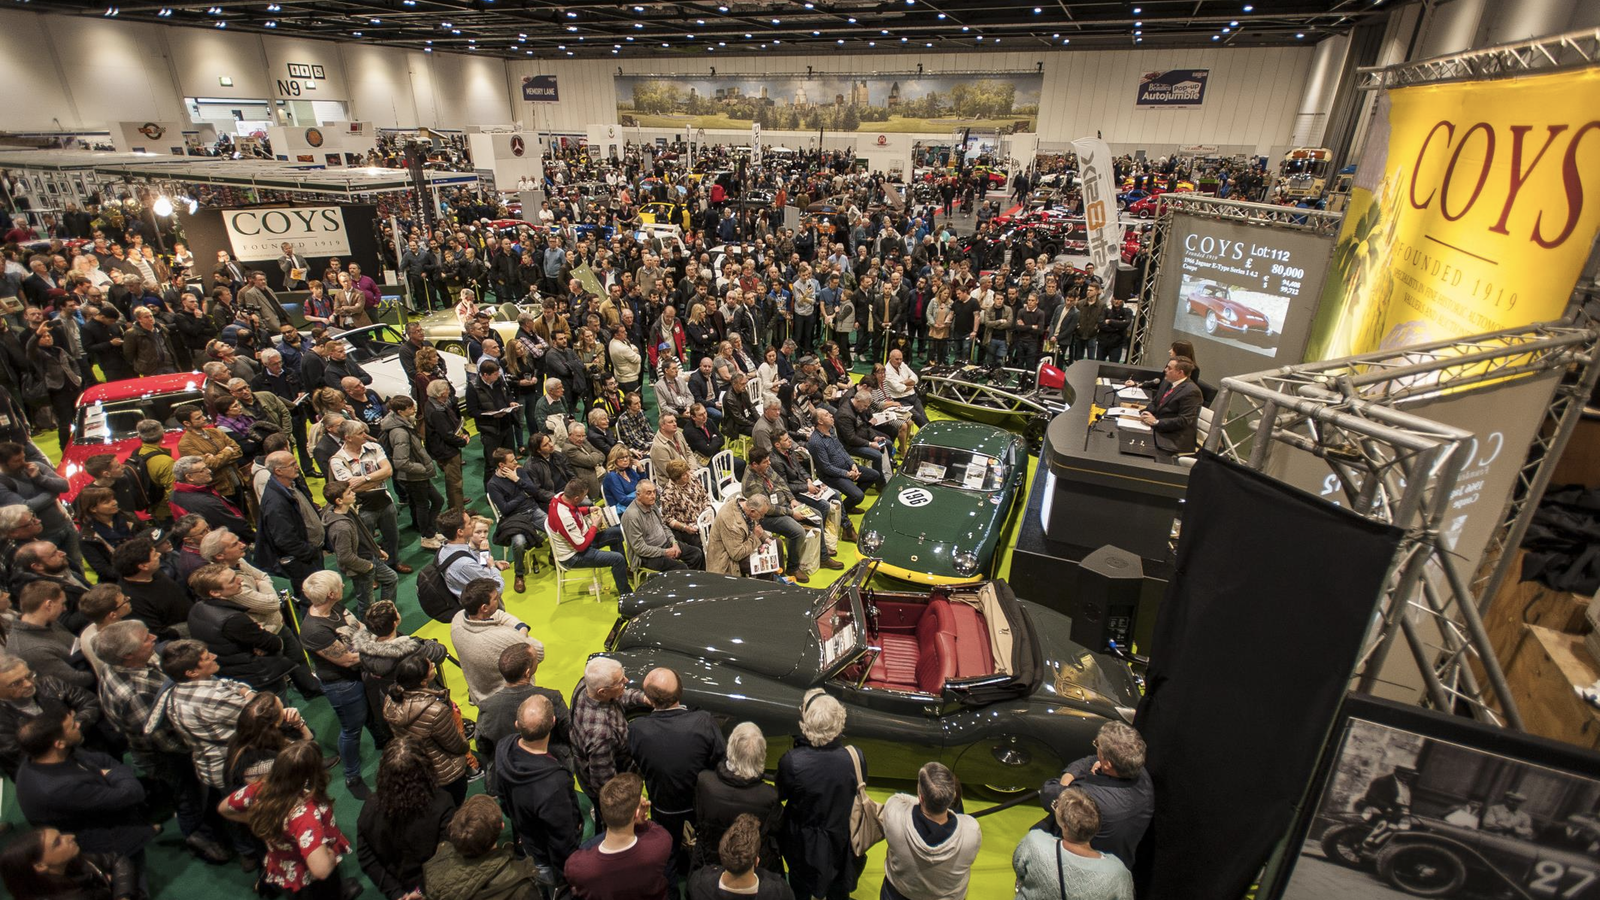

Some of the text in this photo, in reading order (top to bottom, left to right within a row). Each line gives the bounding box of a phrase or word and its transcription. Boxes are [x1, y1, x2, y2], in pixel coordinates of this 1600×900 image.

[277, 80, 301, 96] N9
[1142, 91, 1200, 101] Autojumble
[1173, 83, 1200, 92] Pop-up
[1409, 120, 1600, 249] COYS
[231, 208, 340, 236] COYS
[242, 239, 341, 251] FOUNED 1919
[1185, 233, 1245, 260] COYS
[1183, 263, 1198, 272] Coupe
[1195, 259, 1211, 269] Jaguar
[1212, 262, 1230, 273] E-Type
[1230, 266, 1246, 275] Series
[1244, 257, 1304, 279] £ 80,000
[1397, 242, 1518, 312] FOUNDED 1919
[903, 488, 929, 506] 196
[1529, 860, 1597, 899] 27
